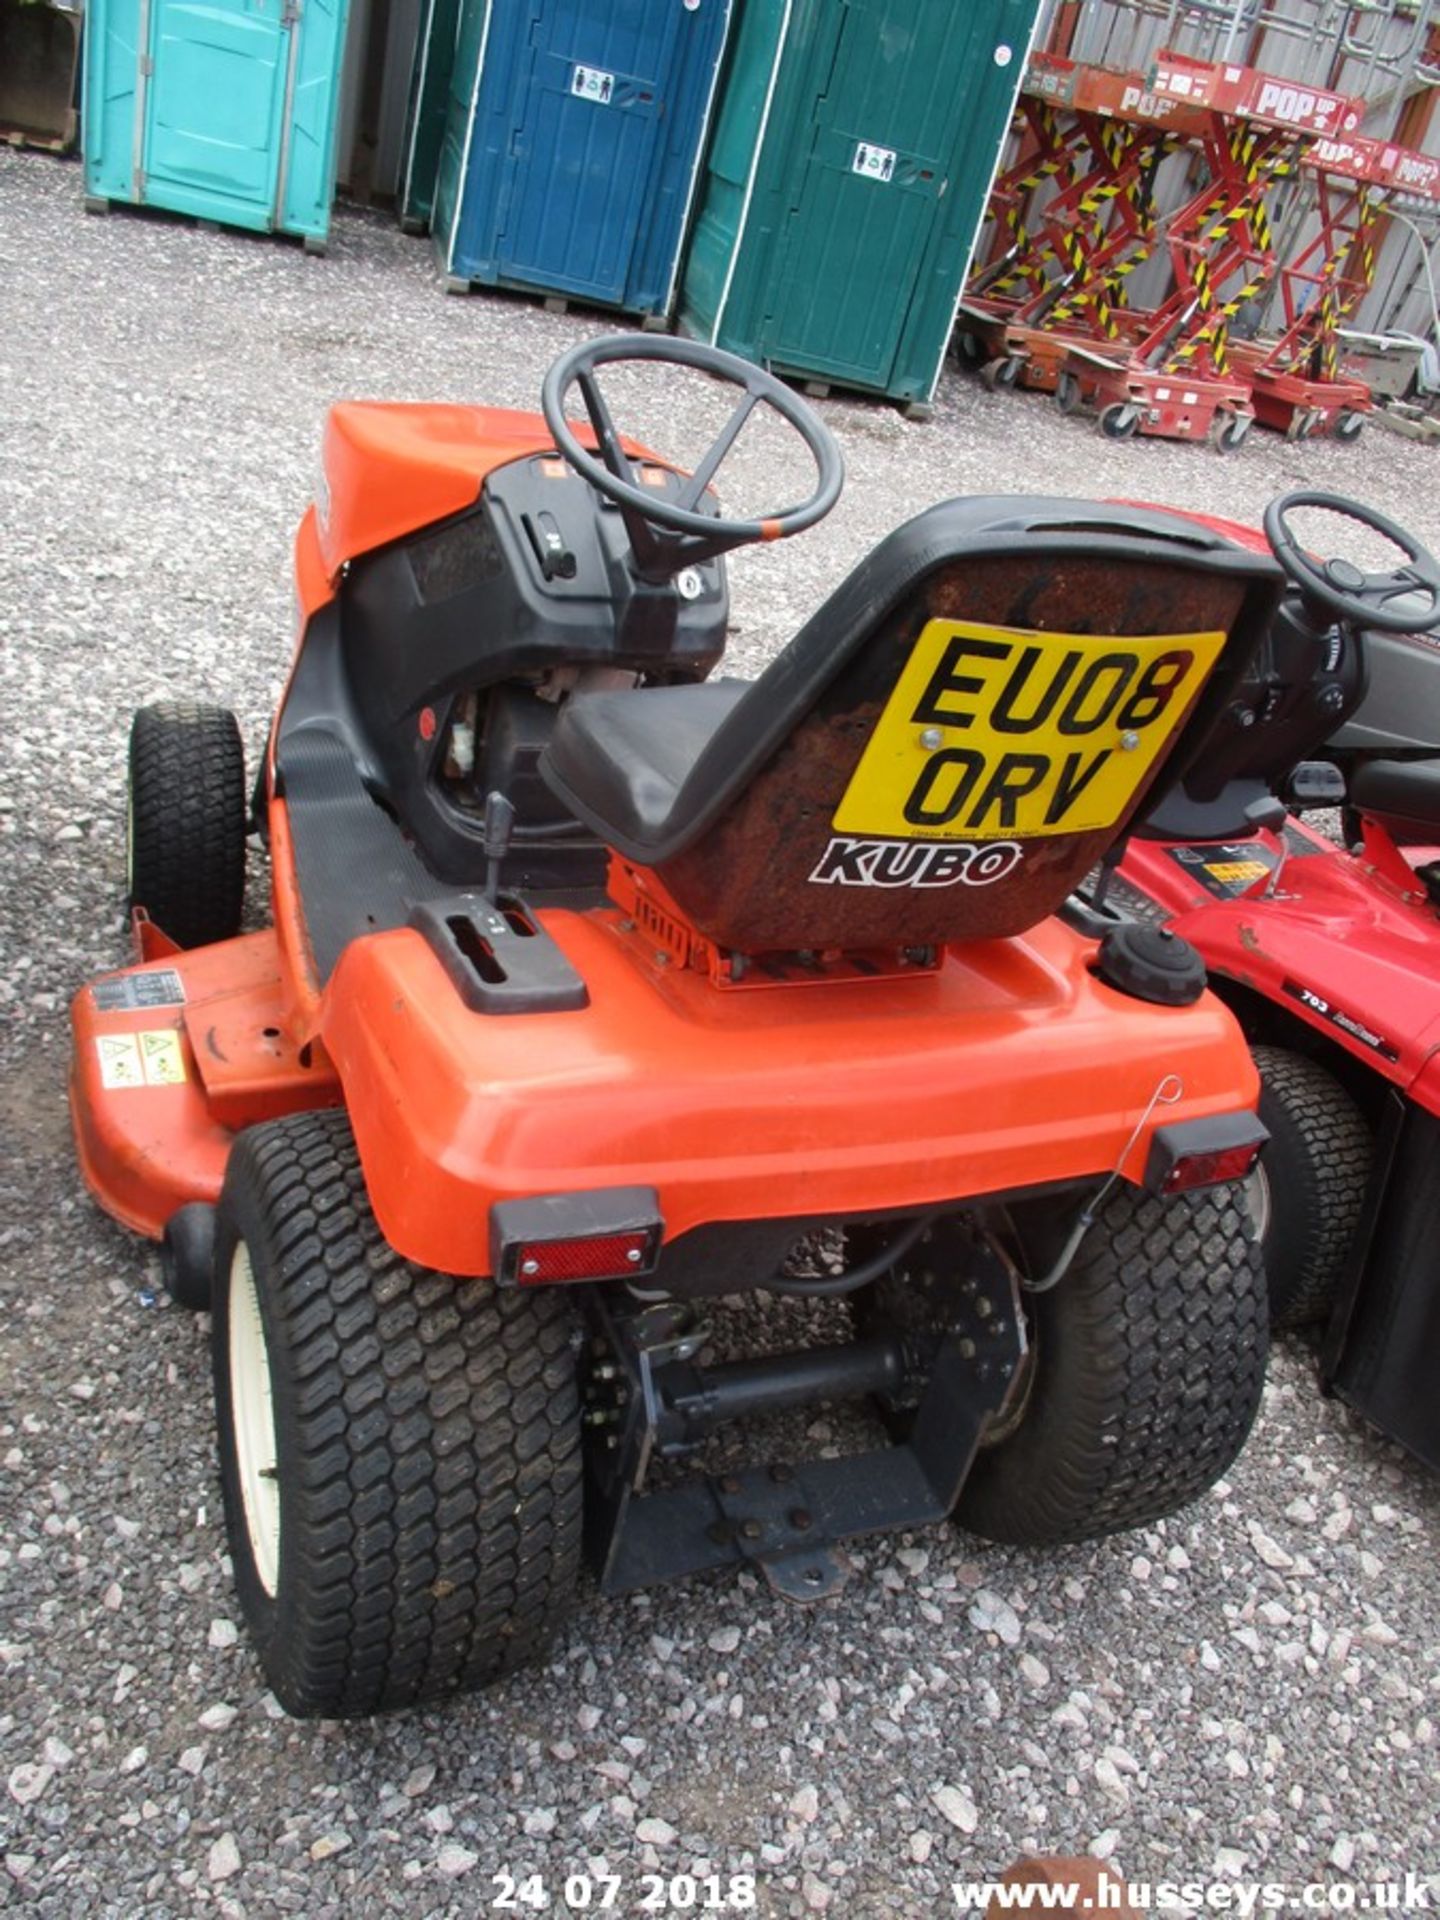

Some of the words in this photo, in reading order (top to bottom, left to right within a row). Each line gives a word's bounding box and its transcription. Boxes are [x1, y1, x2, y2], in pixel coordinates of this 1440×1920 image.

[1257, 83, 1316, 122] POP
[910, 636, 1195, 736] EU08
[903, 748, 1113, 828] ORV
[1301, 989, 1328, 1013] 703
